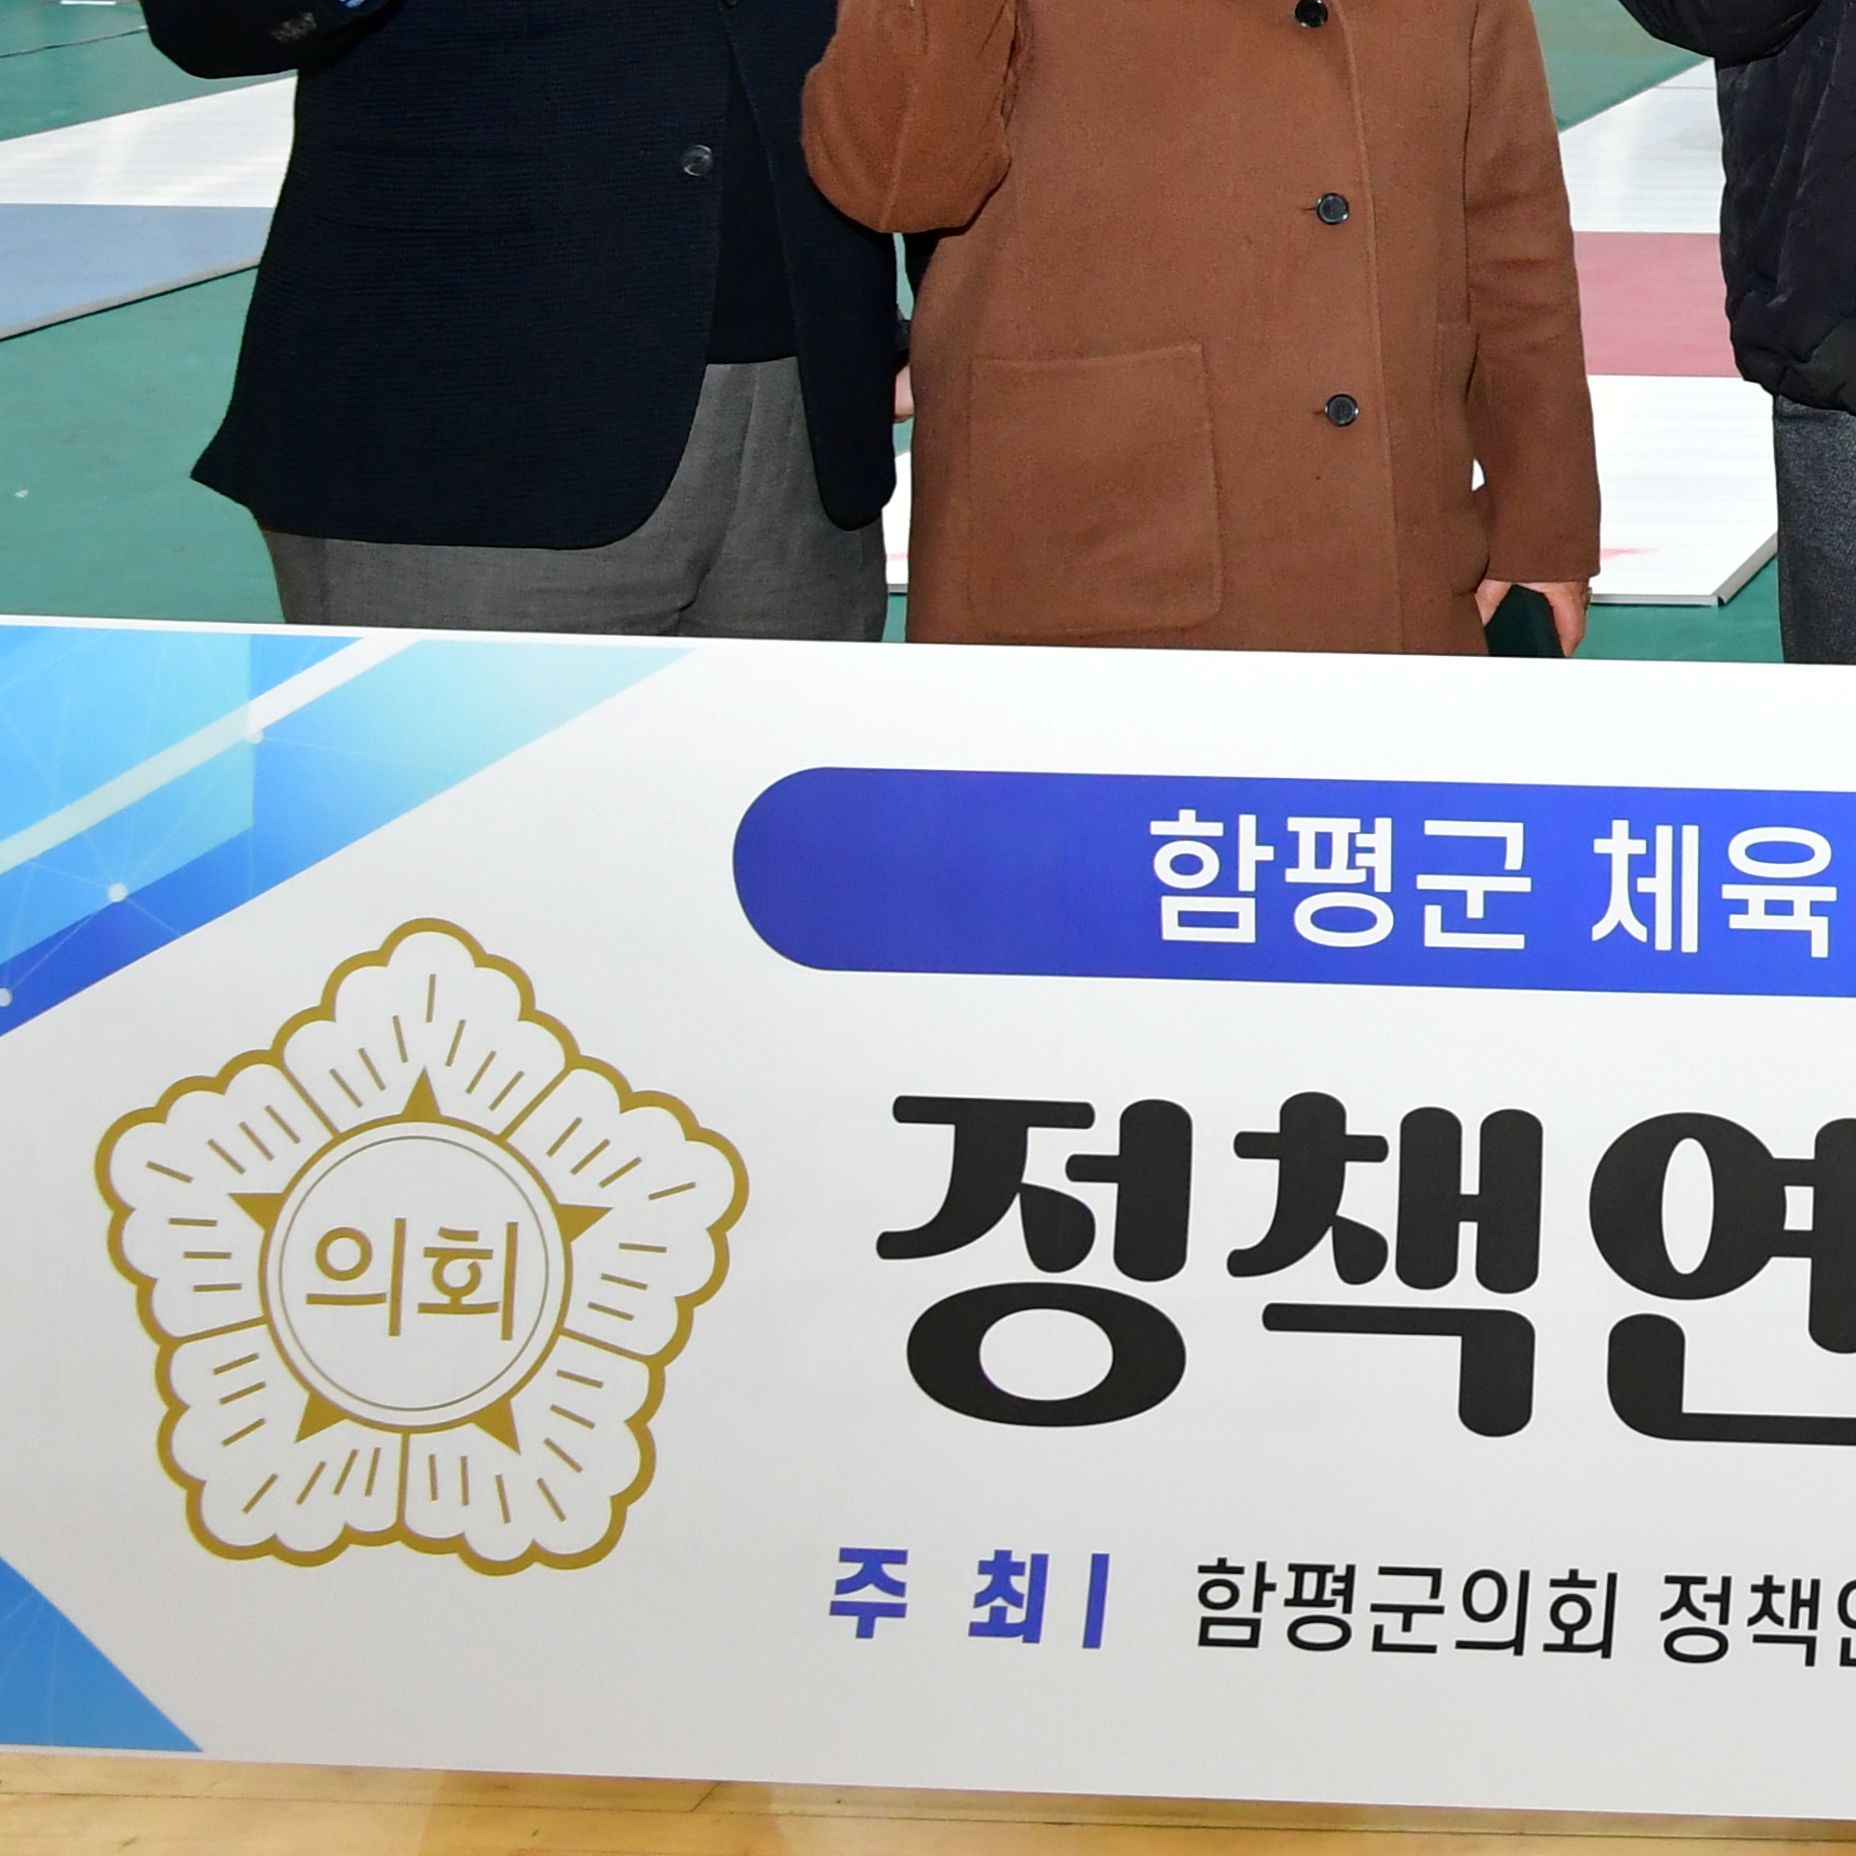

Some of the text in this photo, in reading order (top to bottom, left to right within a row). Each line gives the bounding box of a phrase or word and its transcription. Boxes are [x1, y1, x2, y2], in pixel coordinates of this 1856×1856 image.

[1150, 809, 1532, 950] 함평군
[306, 1218, 518, 1340] 의회
[1197, 1557, 1618, 1660] 함평군의회
